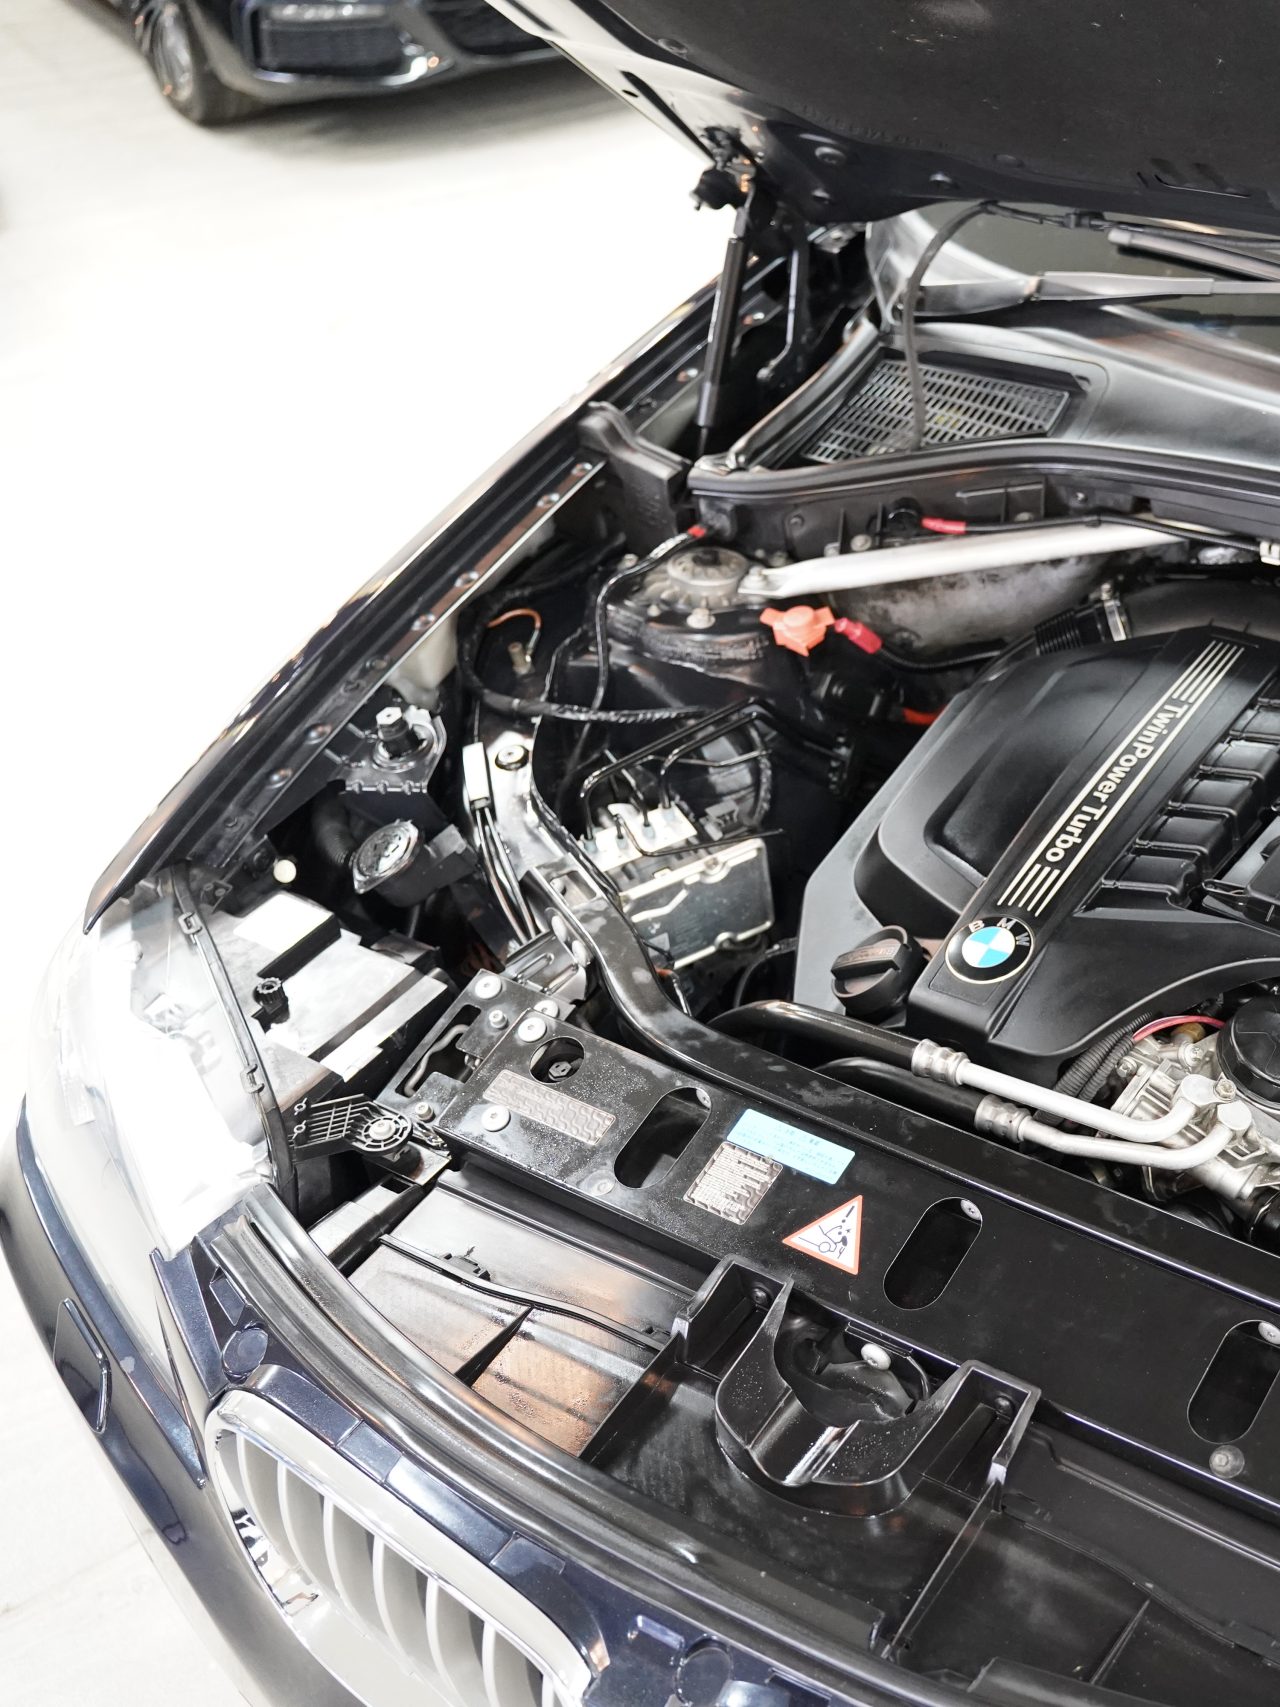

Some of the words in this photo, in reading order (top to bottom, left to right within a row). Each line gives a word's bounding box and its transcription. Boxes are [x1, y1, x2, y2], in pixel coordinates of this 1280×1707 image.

[1093, 704, 1188, 804] TwinPower
[1045, 804, 1108, 862] Turbo
[968, 917, 1031, 947] BMW
